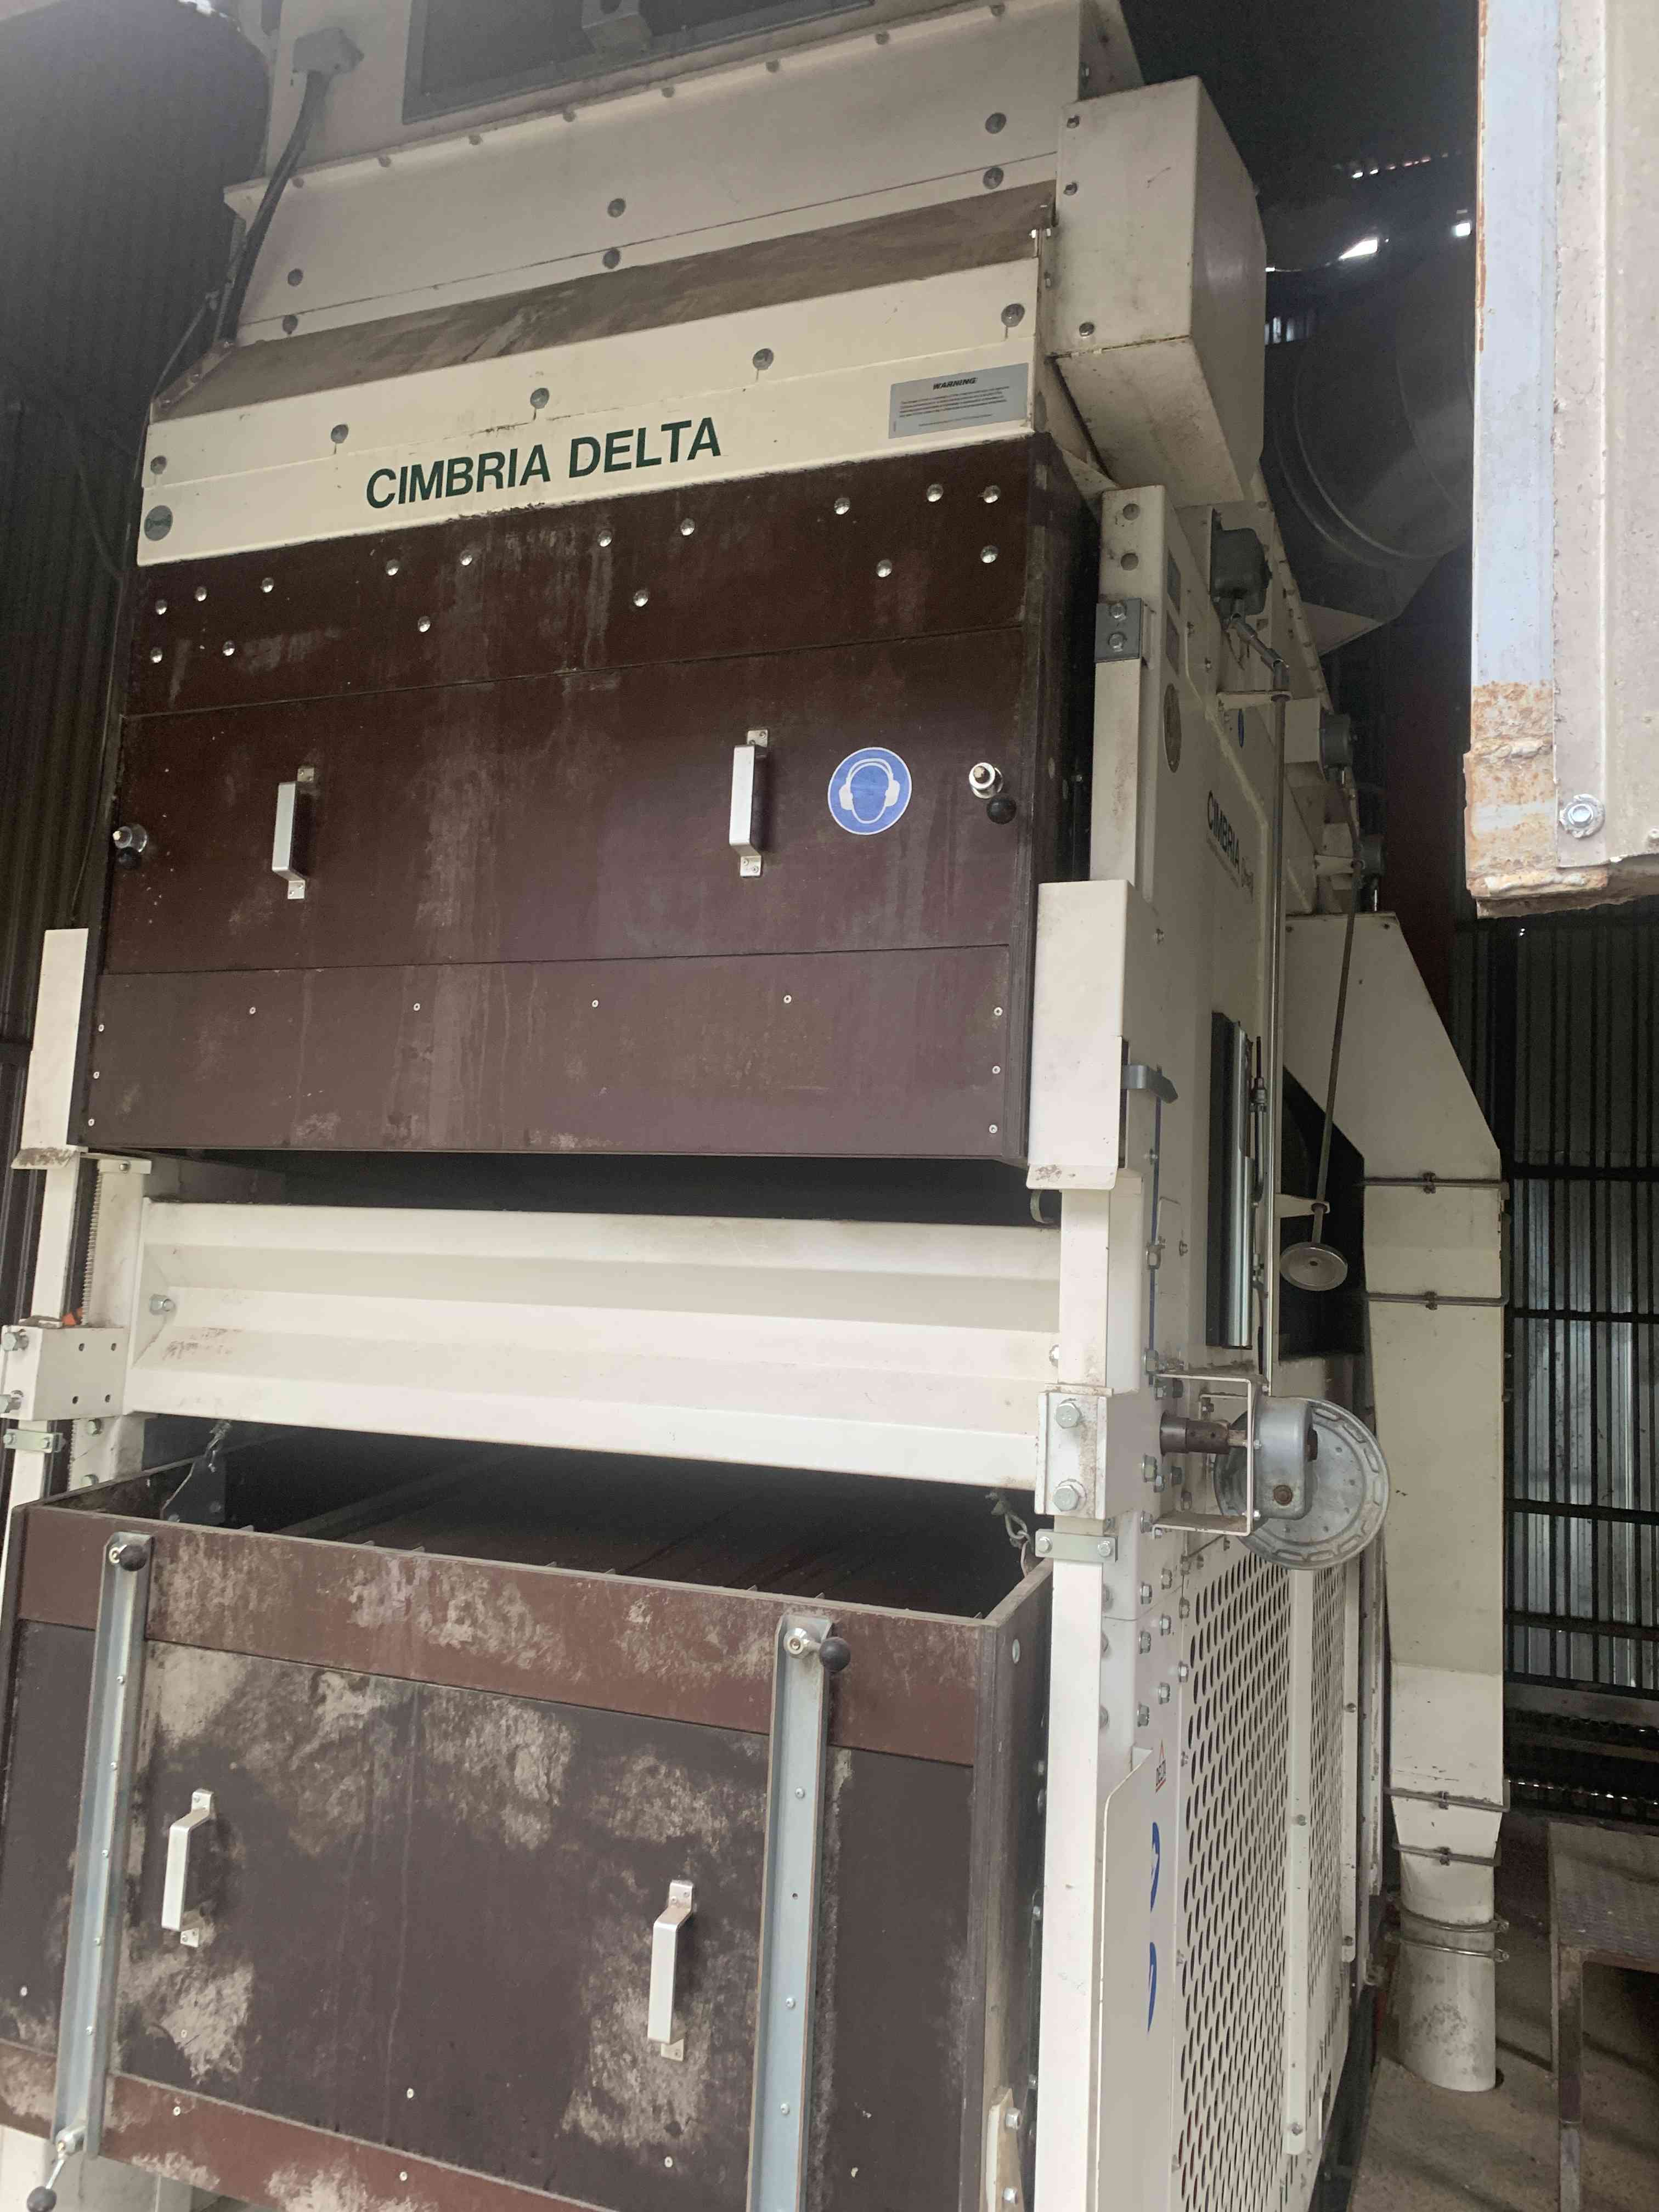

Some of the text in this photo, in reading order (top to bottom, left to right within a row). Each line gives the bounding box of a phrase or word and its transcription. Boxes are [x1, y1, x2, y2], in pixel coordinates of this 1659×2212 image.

[933, 377, 977, 390] WARNING
[366, 416, 721, 509] CIMBRIA DELTA
